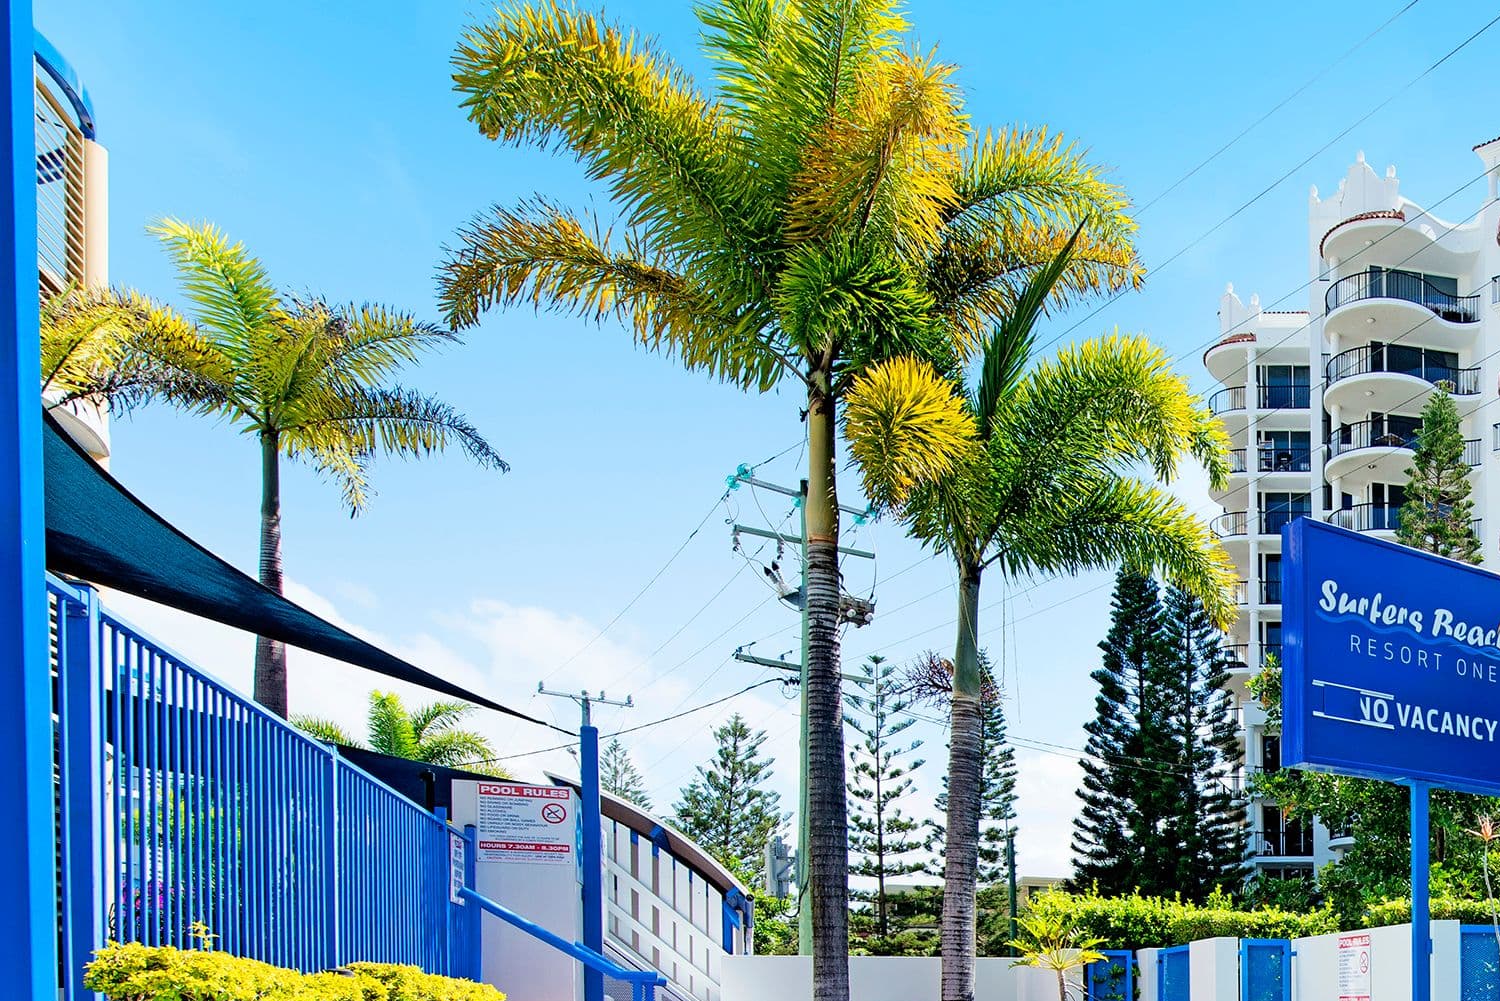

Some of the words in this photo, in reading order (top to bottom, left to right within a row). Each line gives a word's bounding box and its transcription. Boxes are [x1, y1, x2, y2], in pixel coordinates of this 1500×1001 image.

[1319, 580, 1423, 633] Surfers
[1350, 634, 1442, 671] RESORT
[1456, 658, 1497, 683] ONE
[1396, 702, 1497, 742] VACANCY
[480, 786, 520, 795] POOL
[523, 788, 569, 798] RULES
